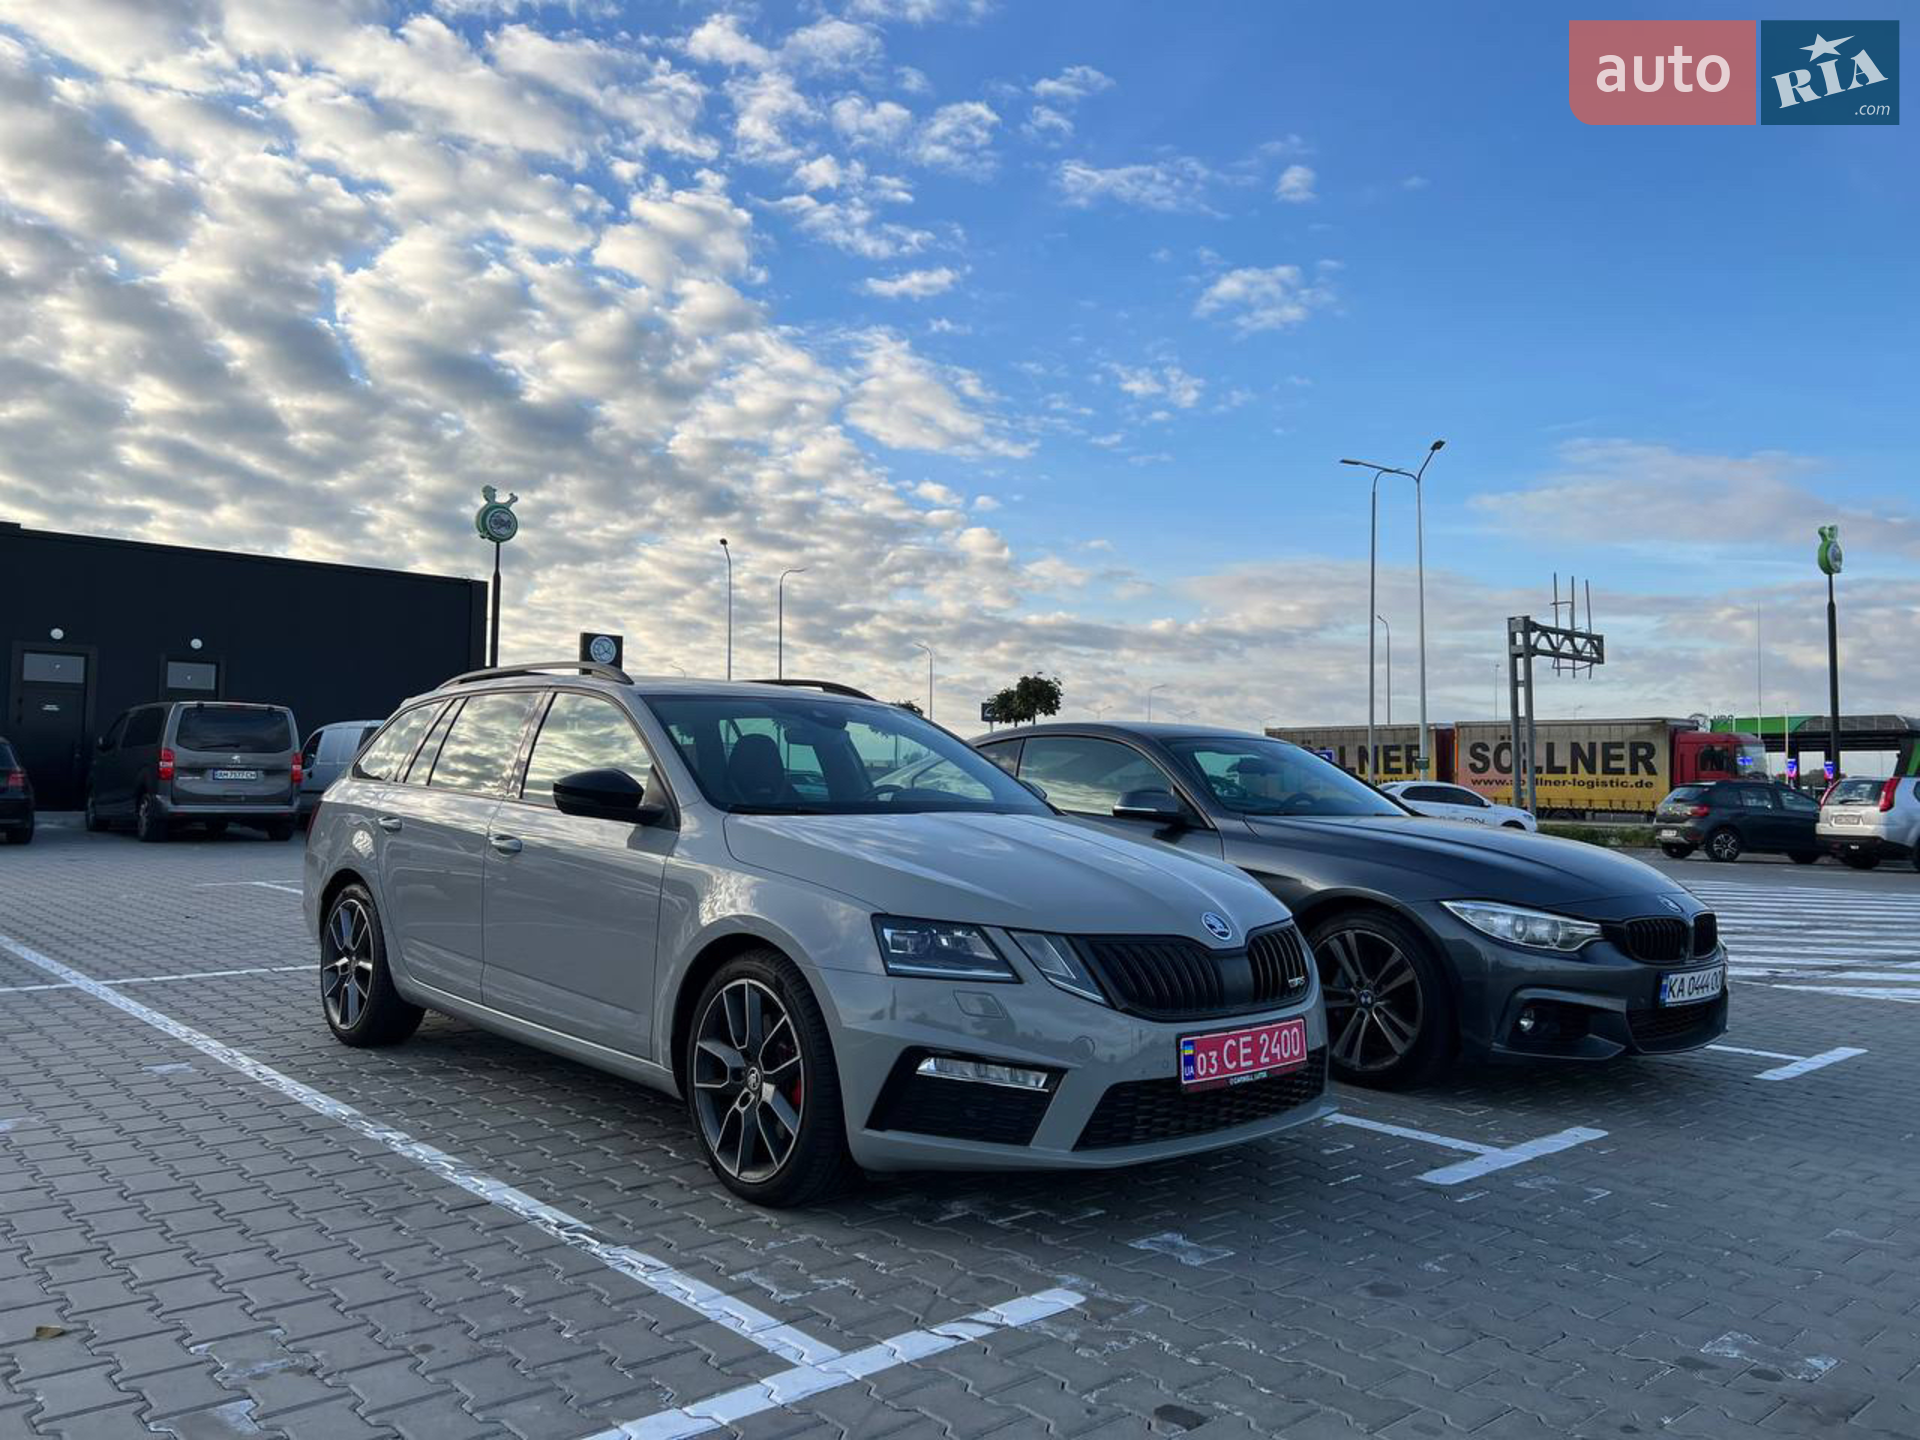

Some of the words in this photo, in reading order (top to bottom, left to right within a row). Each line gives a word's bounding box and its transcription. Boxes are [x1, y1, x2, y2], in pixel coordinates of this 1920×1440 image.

[1668, 977, 1685, 999] KA
[1197, 1050, 1219, 1077] 03
[1223, 1036, 1254, 1069] CE
[1260, 1027, 1301, 1064] 2400
